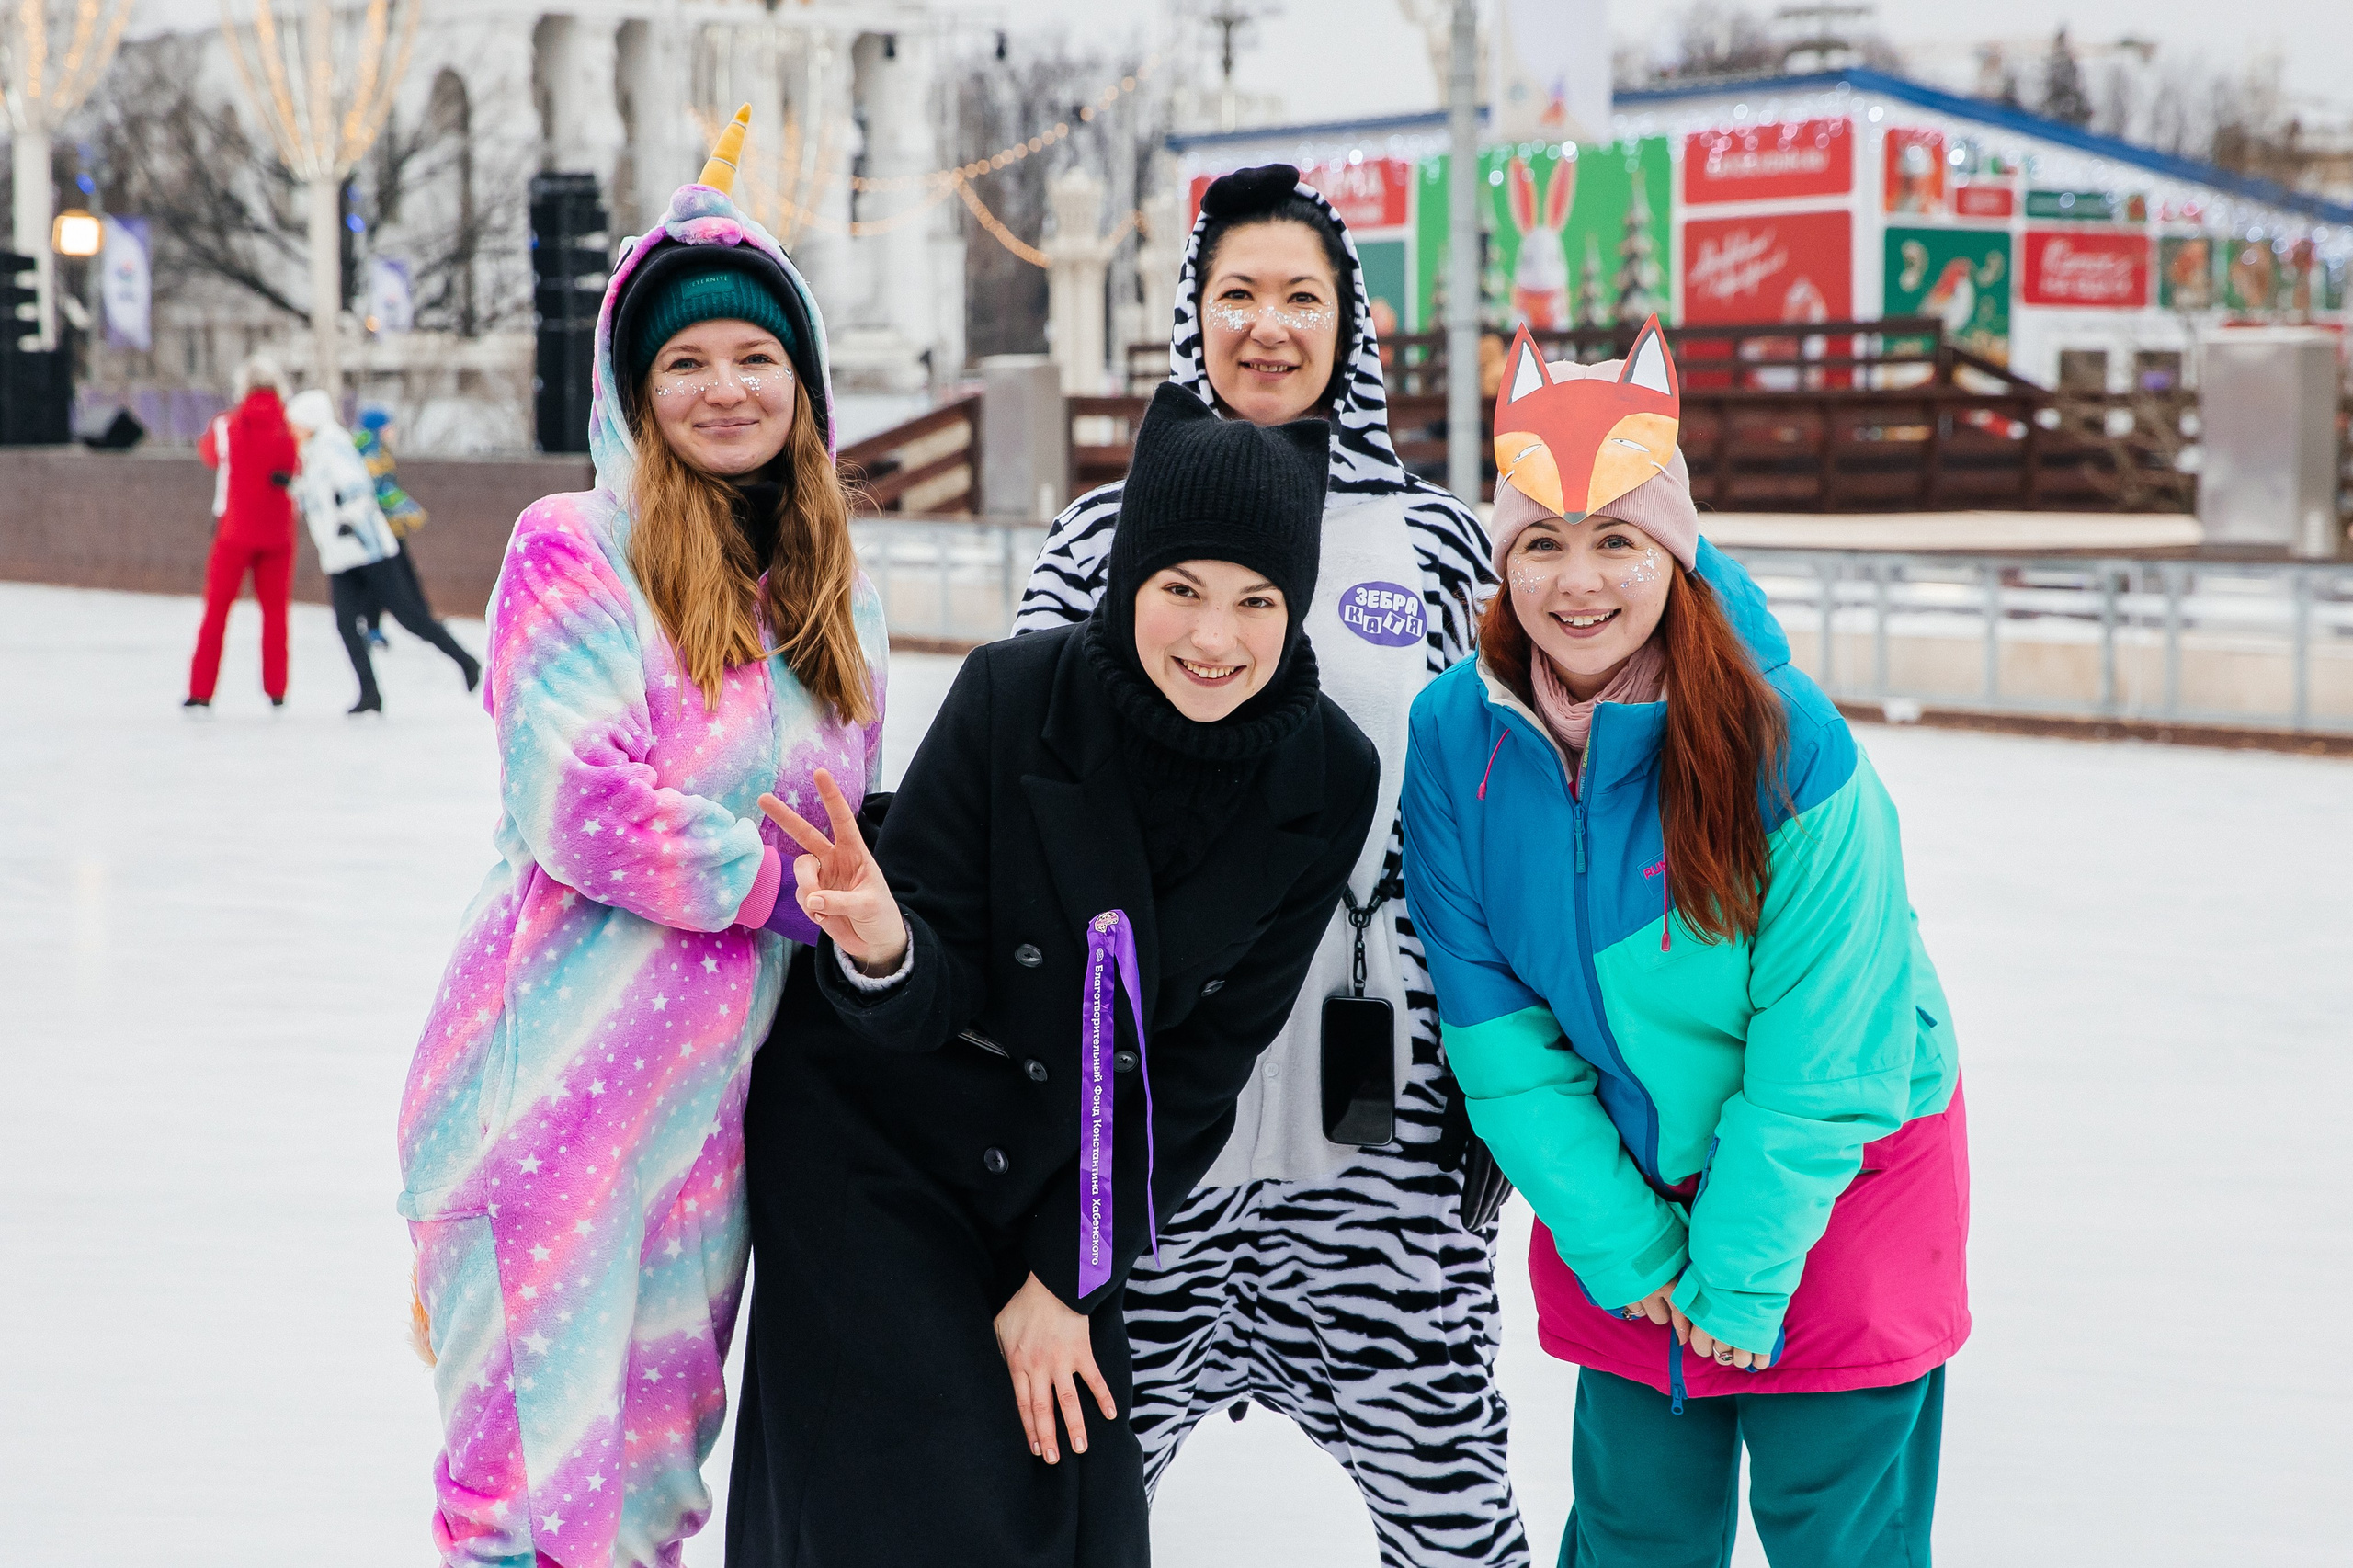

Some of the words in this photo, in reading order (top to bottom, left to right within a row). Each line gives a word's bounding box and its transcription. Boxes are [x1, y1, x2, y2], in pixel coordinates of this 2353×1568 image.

[1346, 605, 1422, 637] КАТЯ
[1355, 587, 1419, 617] ЗЕБРА
[1091, 964, 1104, 1083] Благотворительный
[1091, 1085, 1103, 1117] Фонд
[1091, 1119, 1102, 1196] Константина
[1091, 1199, 1102, 1266] Хабенского
